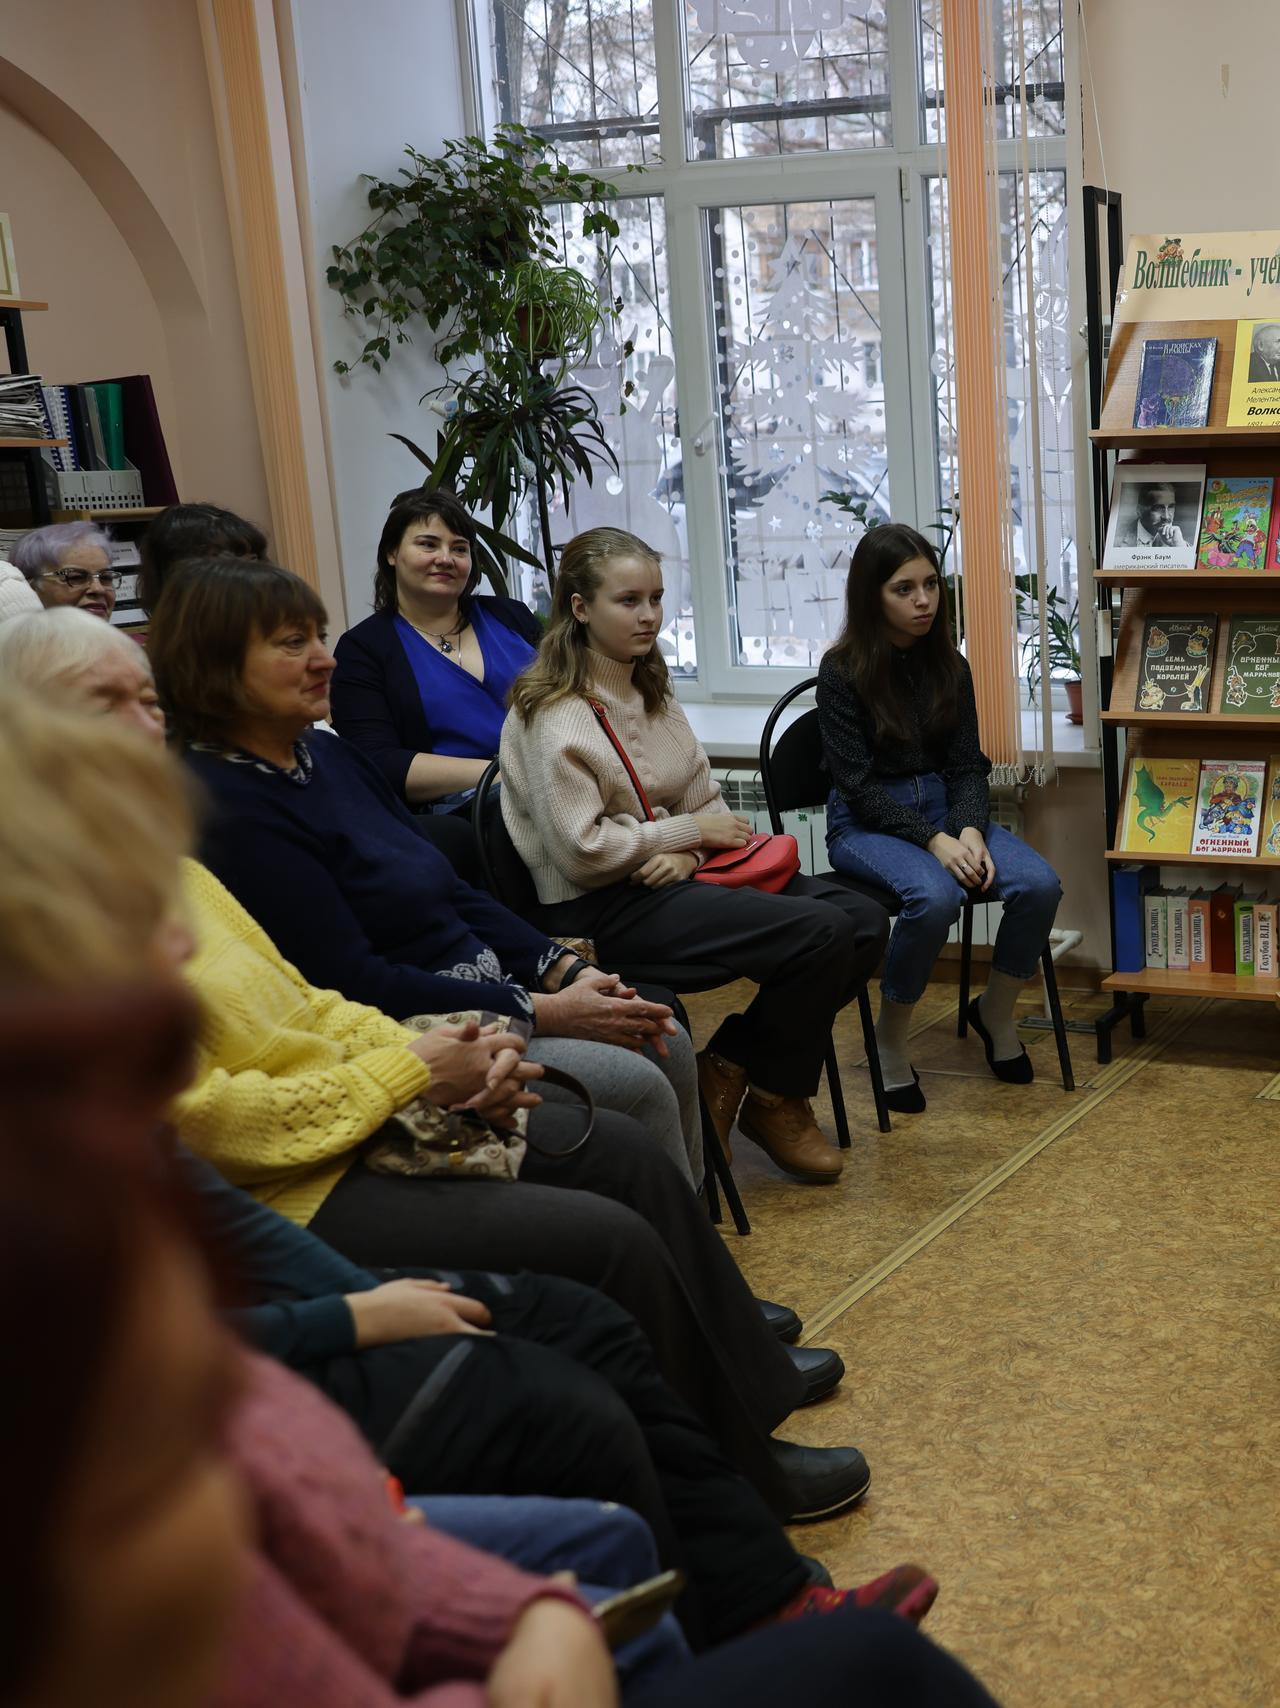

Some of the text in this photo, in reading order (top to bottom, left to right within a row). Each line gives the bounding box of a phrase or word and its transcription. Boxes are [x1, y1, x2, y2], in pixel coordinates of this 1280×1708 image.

[1133, 248, 1232, 290] Волшебник
[1131, 553, 1171, 561] Фрэнк Баум
[1157, 672, 1190, 680] КОРОЛЕЙ
[1200, 838, 1249, 846] ОГНЕННЫЙ
[1151, 908, 1159, 955] РУКОДЕЛЬНИЦА
[1175, 908, 1183, 955] РУКОДЕЛЬНИЦА
[1192, 914, 1202, 962] РУКОДЕЛЬНИЦА
[1259, 922, 1269, 971] Голубов В.П.
